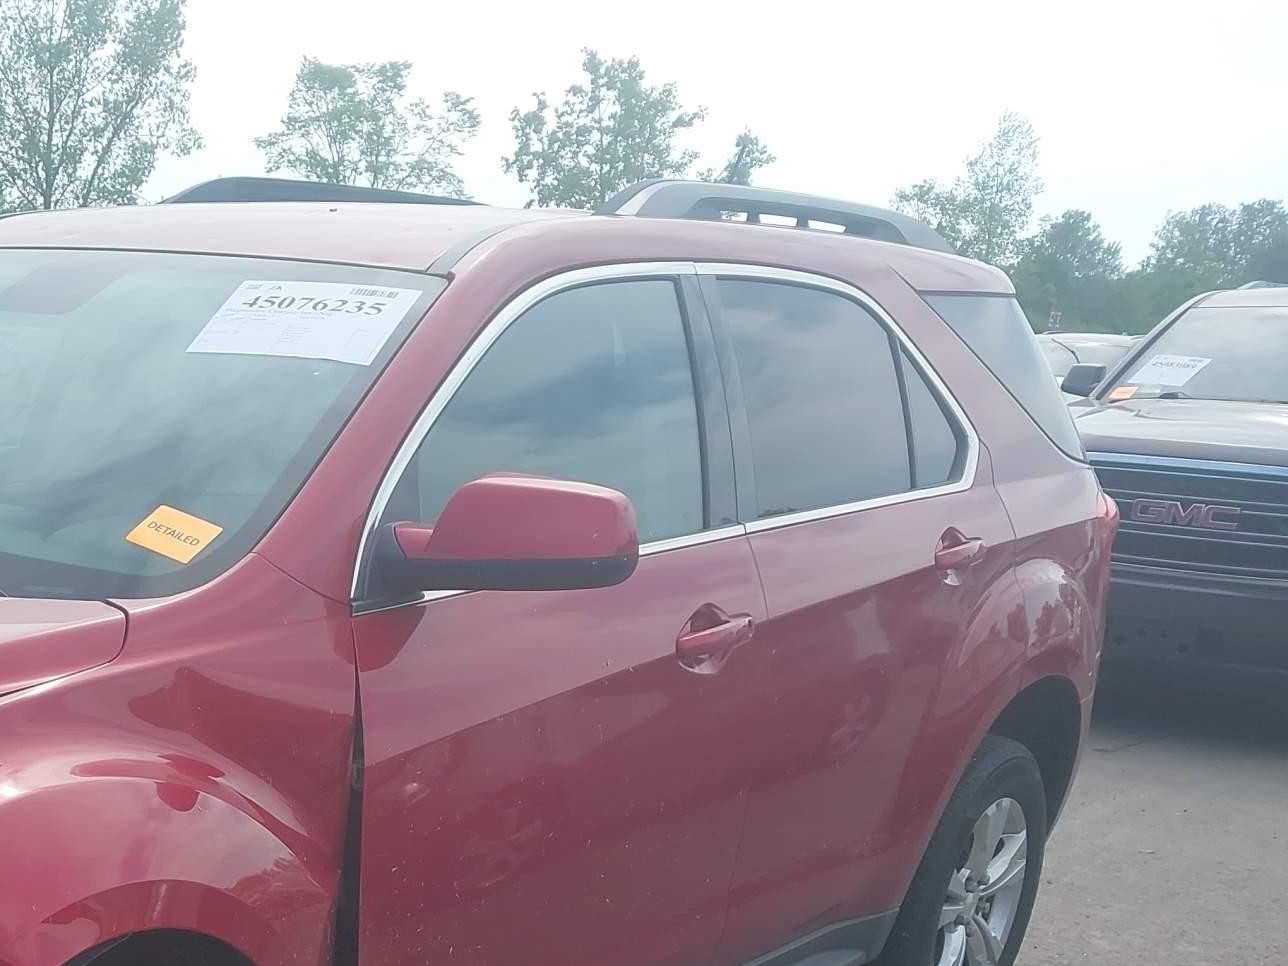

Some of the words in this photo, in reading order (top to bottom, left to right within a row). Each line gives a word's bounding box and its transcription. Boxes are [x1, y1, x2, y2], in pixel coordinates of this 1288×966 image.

[242, 295, 388, 316] 45076235
[1130, 498, 1241, 529] GMC
[146, 520, 201, 547] DETAILED
